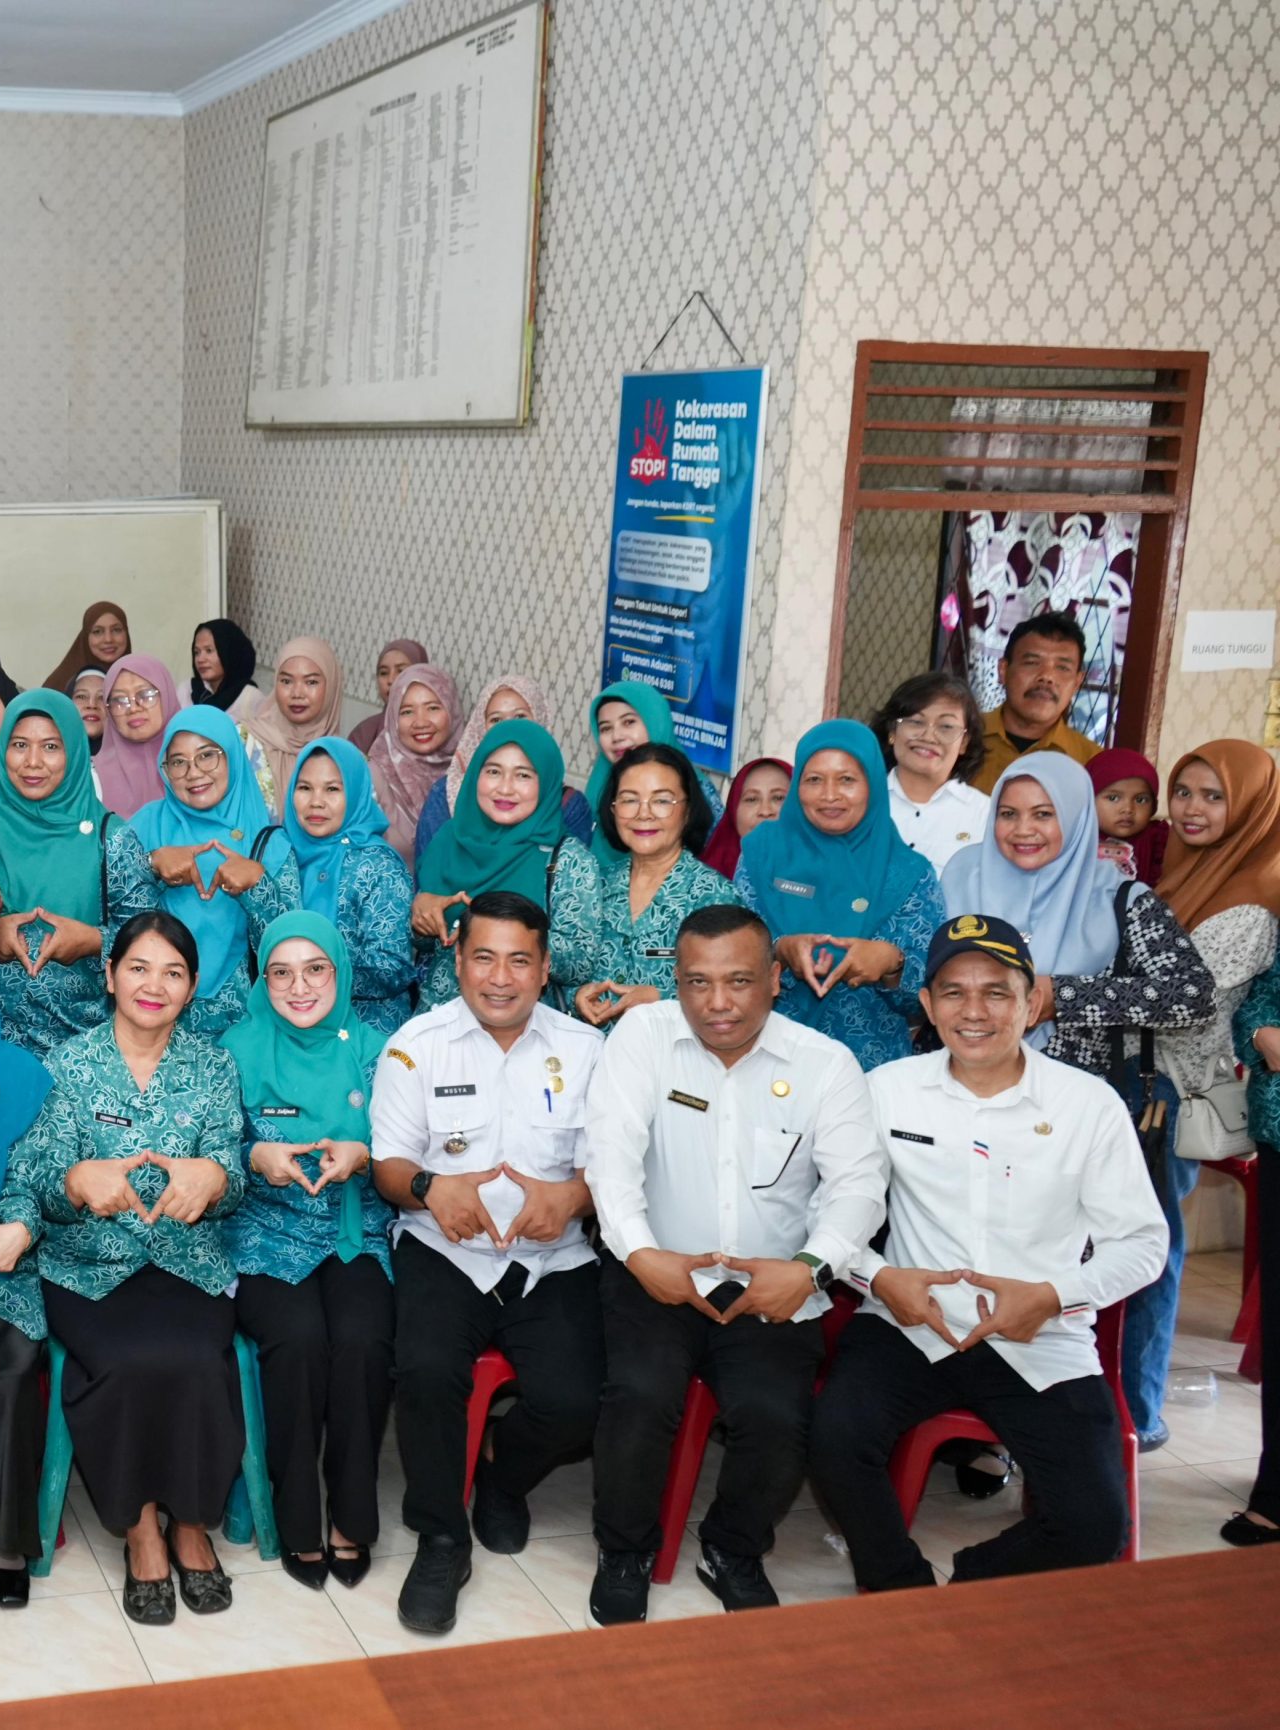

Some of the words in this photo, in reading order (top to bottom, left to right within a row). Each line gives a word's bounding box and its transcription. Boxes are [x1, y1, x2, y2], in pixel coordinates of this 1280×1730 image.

[675, 399, 748, 419] Kekerasan
[674, 420, 717, 440] Dalam
[672, 442, 719, 461] Rumah
[630, 458, 666, 477] STOP!
[671, 463, 721, 489] Tangga
[614, 597, 635, 610] Jangan
[635, 600, 651, 611] Takut
[651, 602, 669, 615] Untuk
[1191, 643, 1225, 655] RUANG
[1227, 643, 1267, 655] TUNGGU
[622, 651, 650, 667] Layanan
[650, 657, 673, 673] Aduan
[678, 724, 700, 742] KOTA
[700, 731, 727, 750] BINJAI
